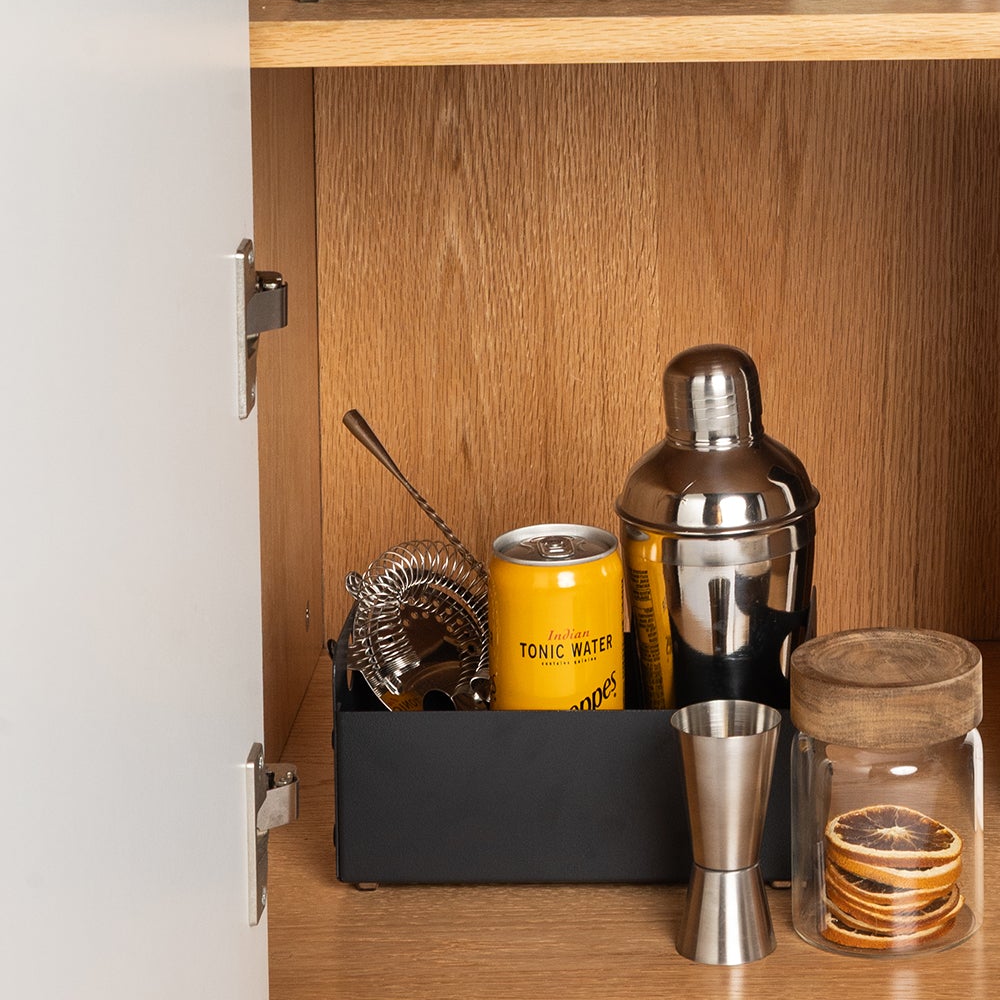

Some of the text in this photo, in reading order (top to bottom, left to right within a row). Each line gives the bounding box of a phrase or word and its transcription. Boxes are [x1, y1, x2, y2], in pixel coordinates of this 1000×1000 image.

[547, 628, 590, 641] Indian
[520, 634, 613, 659] TONIC WATER
